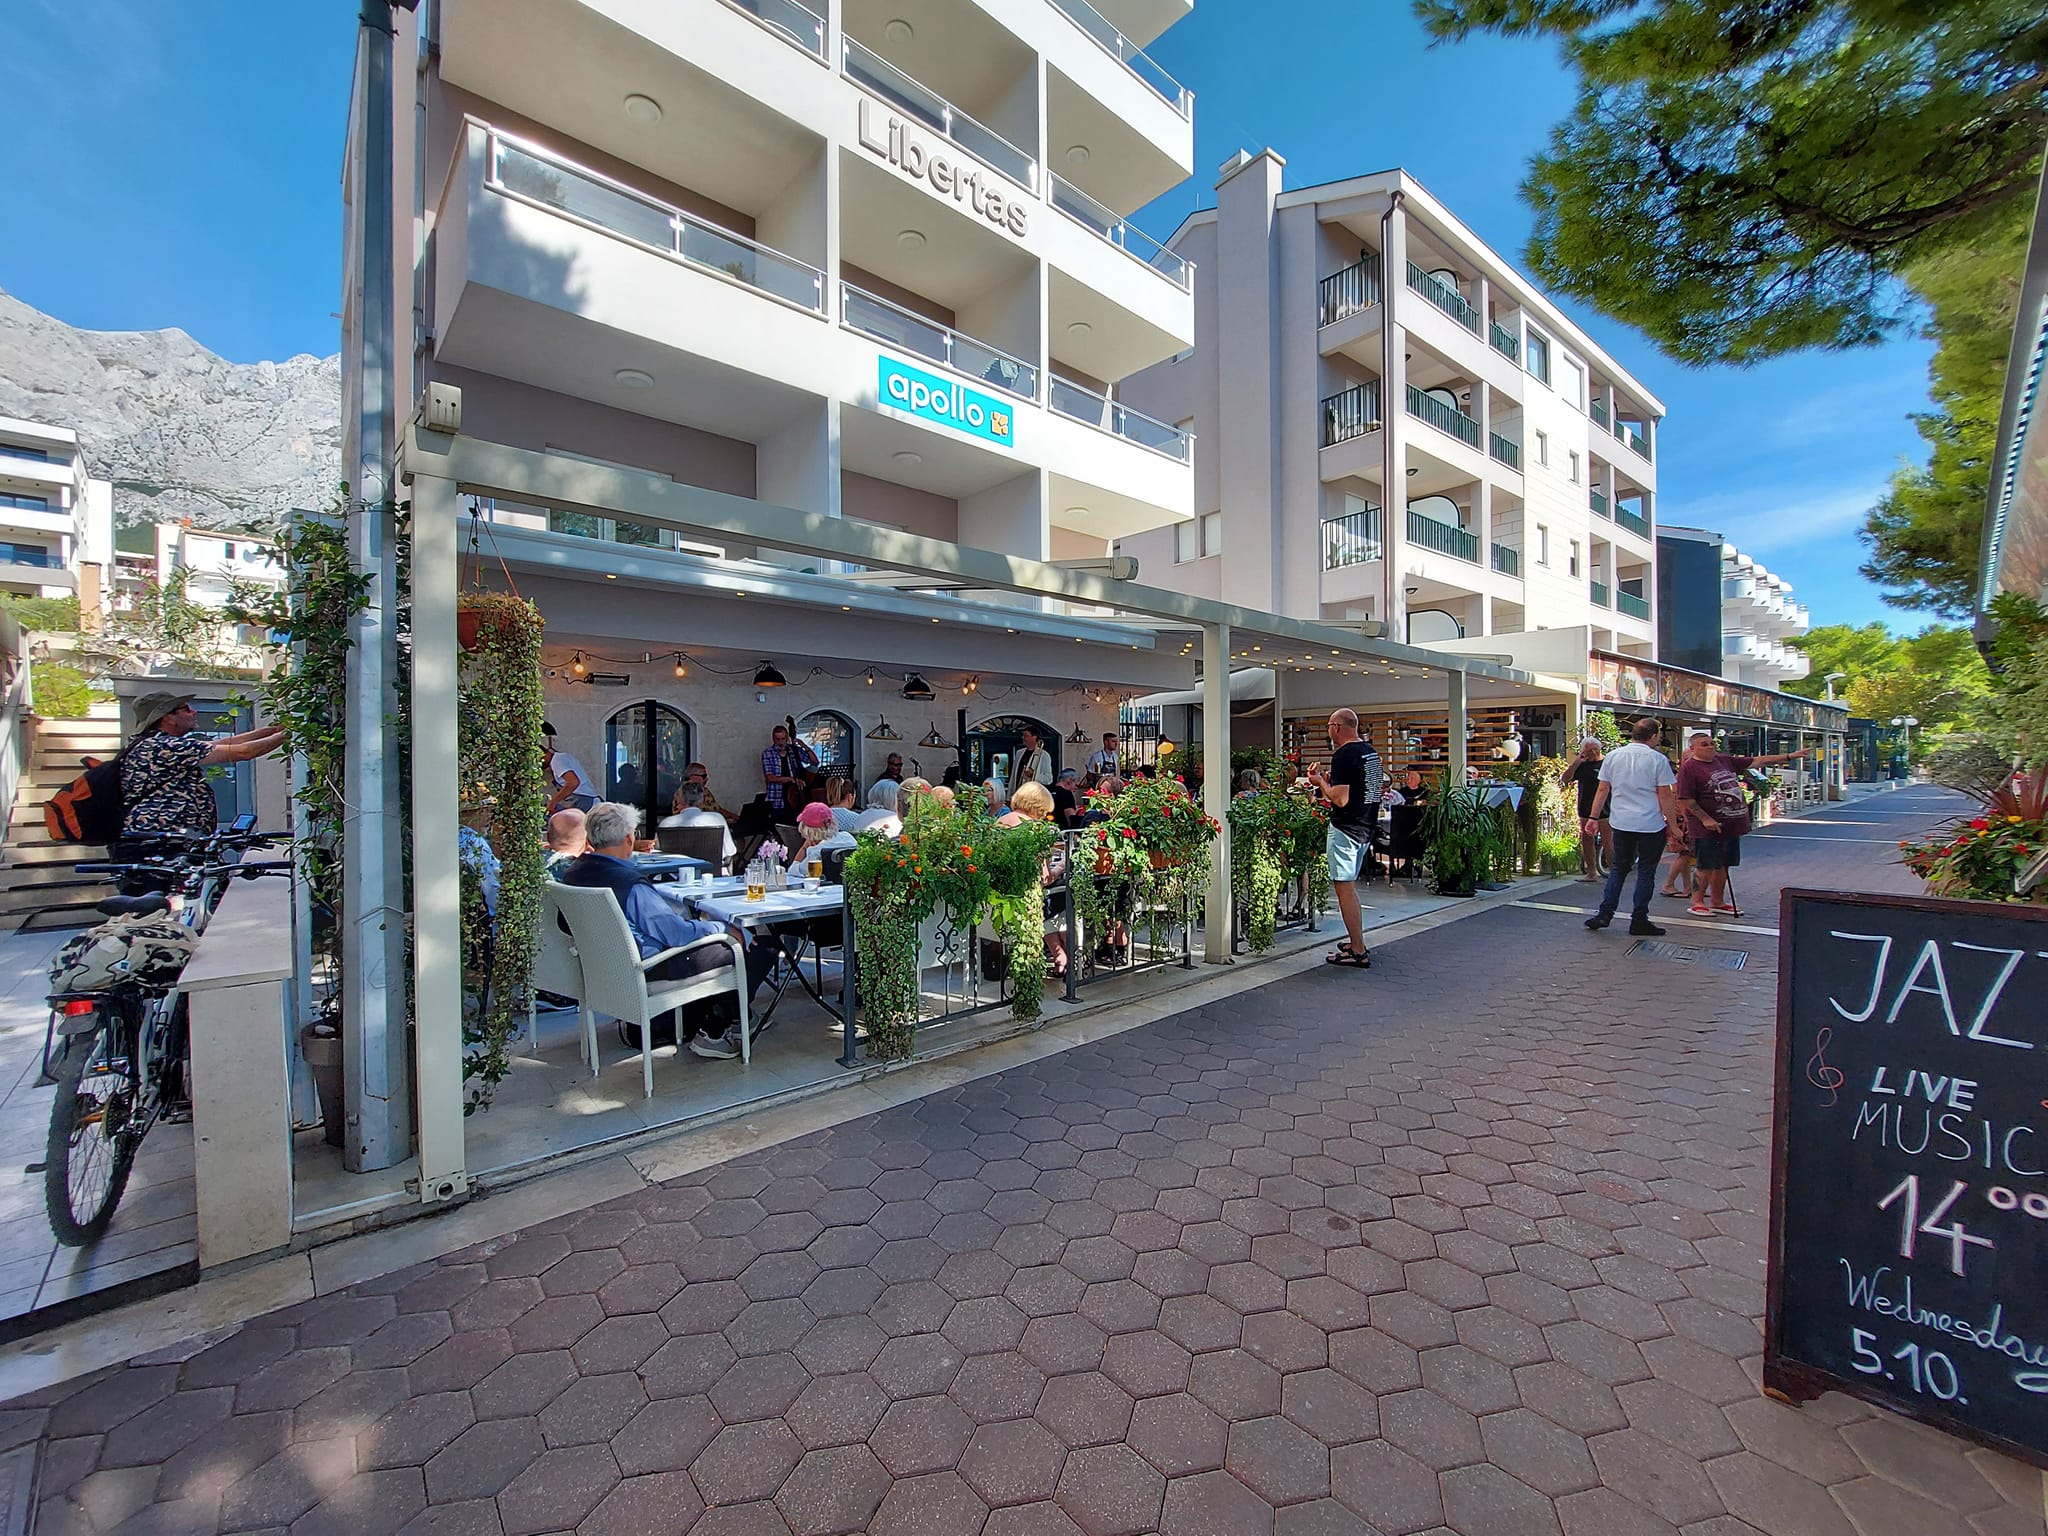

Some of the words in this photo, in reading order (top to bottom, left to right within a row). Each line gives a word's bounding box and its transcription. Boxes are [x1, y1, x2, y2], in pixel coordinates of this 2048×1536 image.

[859, 97, 1029, 238] Libertas
[888, 372, 985, 427] apollo
[1829, 930, 2048, 1049] JAZ
[1871, 1066, 1978, 1112] LIVE
[1852, 1101, 2045, 1175] MUSIC
[1851, 1327, 1969, 1406] 5.10.
